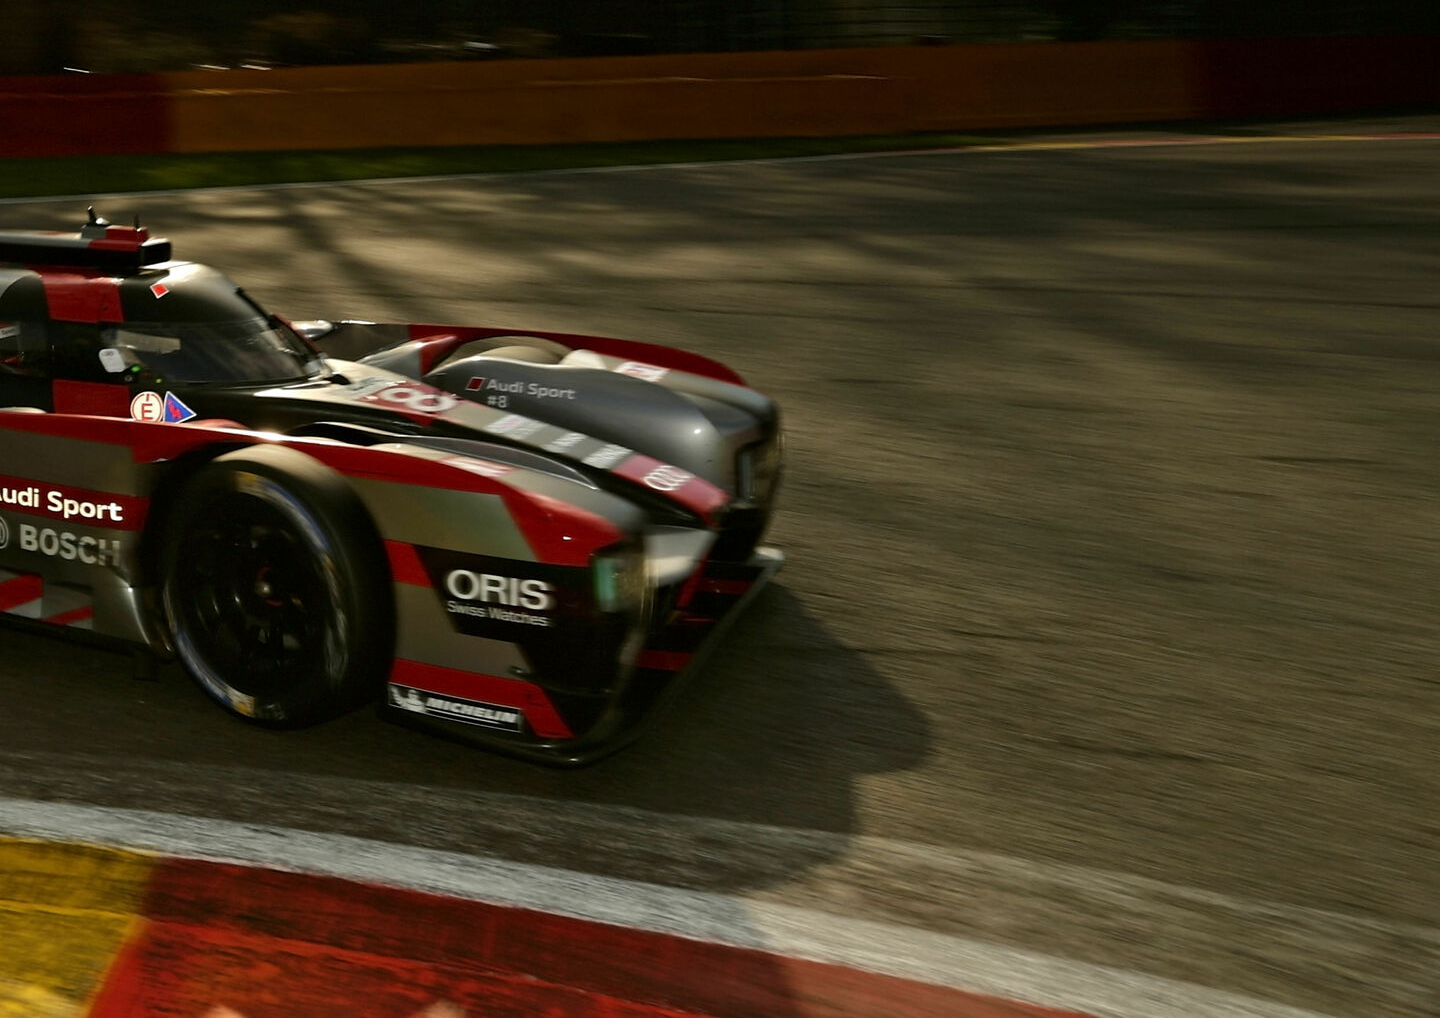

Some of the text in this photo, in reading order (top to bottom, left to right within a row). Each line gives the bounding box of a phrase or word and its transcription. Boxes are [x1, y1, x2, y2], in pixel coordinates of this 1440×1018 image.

[486, 378, 576, 400] Audi Sport
[487, 394, 508, 409] #8
[141, 403, 153, 421] E
[46, 490, 124, 522] Sport
[19, 523, 121, 567] BOSCH
[446, 569, 552, 611] ORIS
[447, 600, 552, 627] Swiss Watches
[426, 697, 518, 724] MICHELIN
